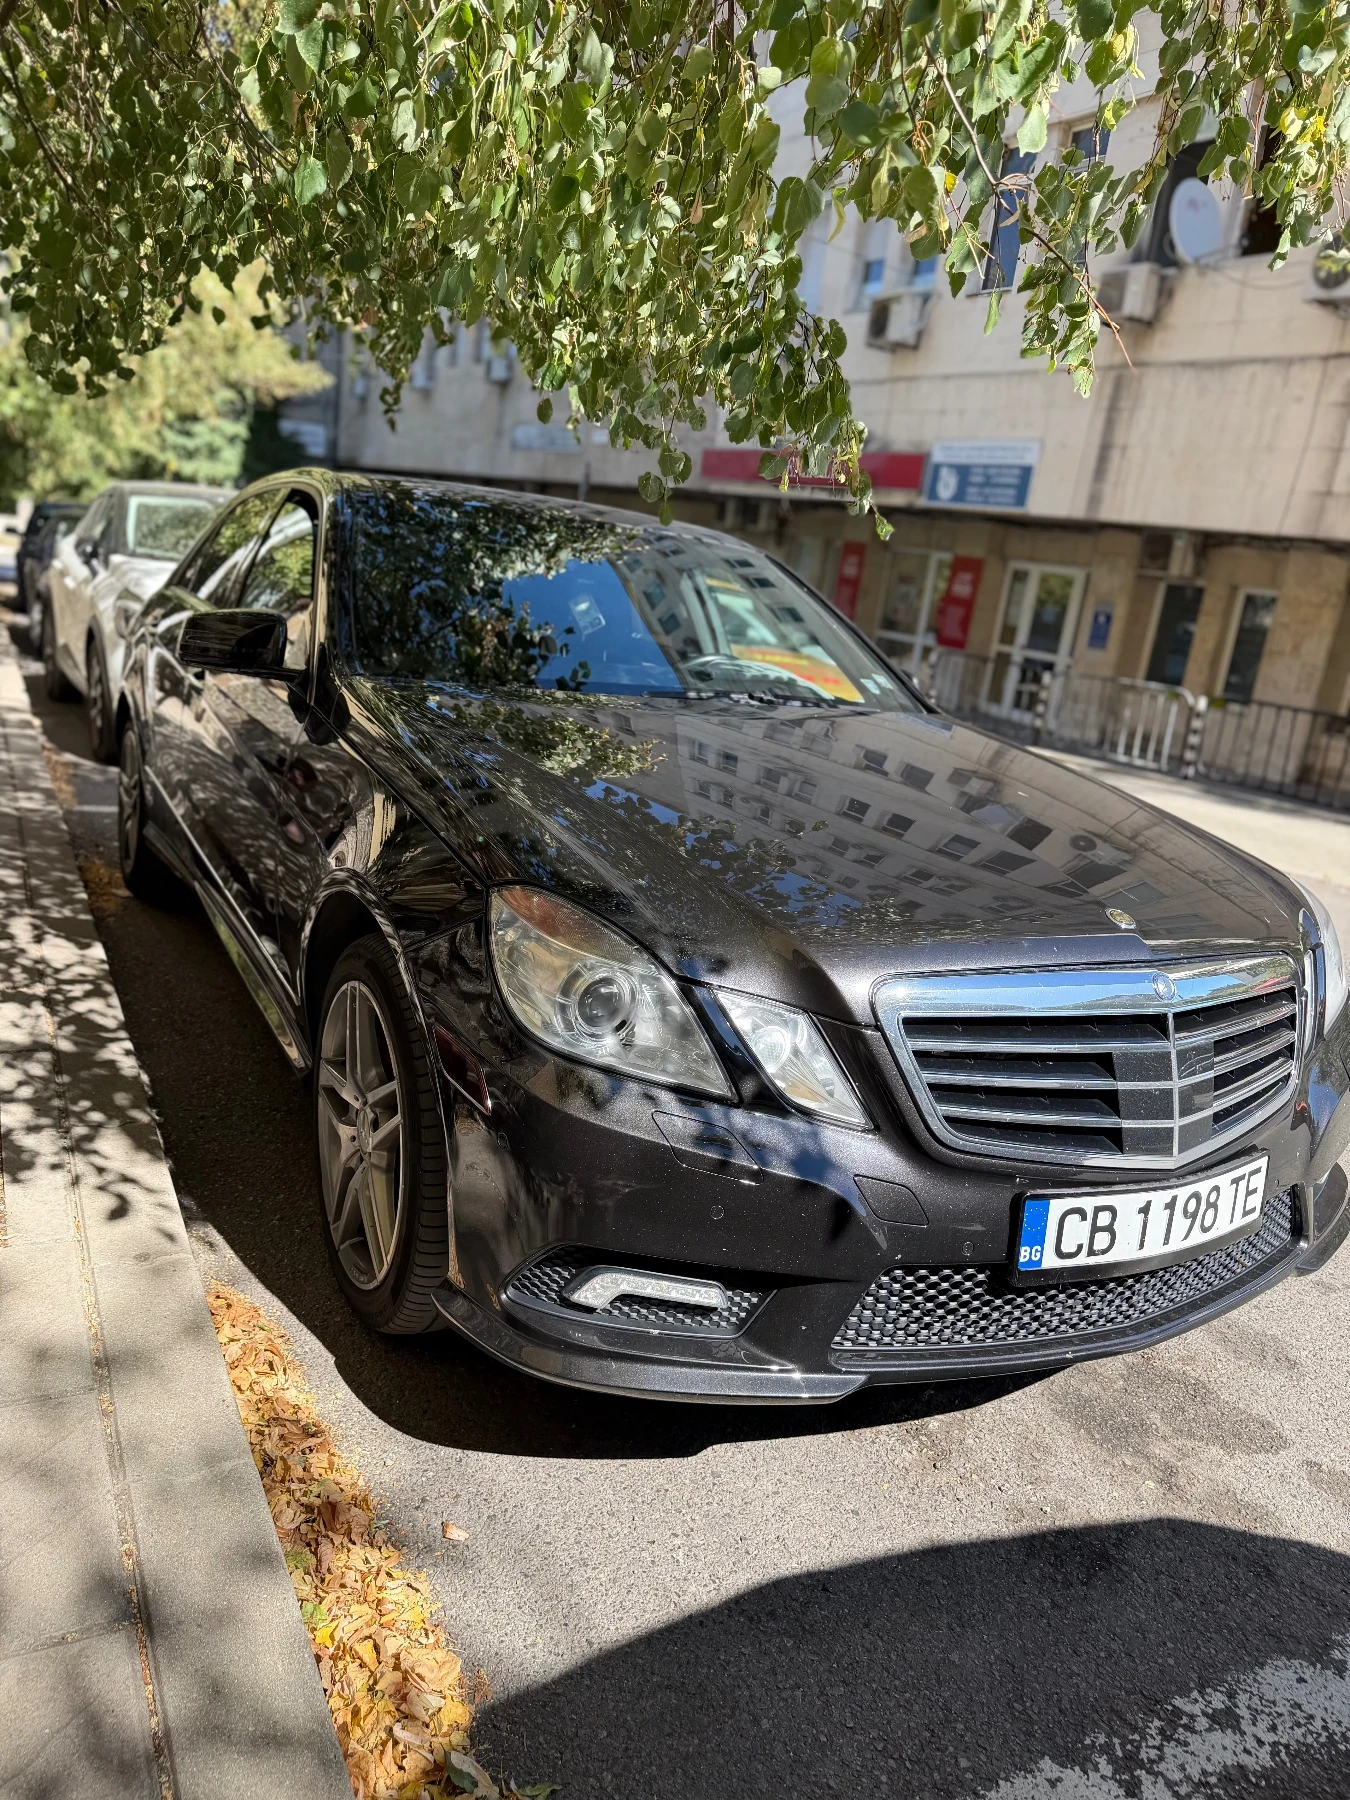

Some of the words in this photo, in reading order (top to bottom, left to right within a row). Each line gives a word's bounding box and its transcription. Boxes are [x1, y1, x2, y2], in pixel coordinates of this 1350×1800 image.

[1054, 1204, 1118, 1260] CB
[1137, 1185, 1221, 1251] 1198
[1229, 1166, 1263, 1225] TE
[1019, 1245, 1042, 1262] BG
